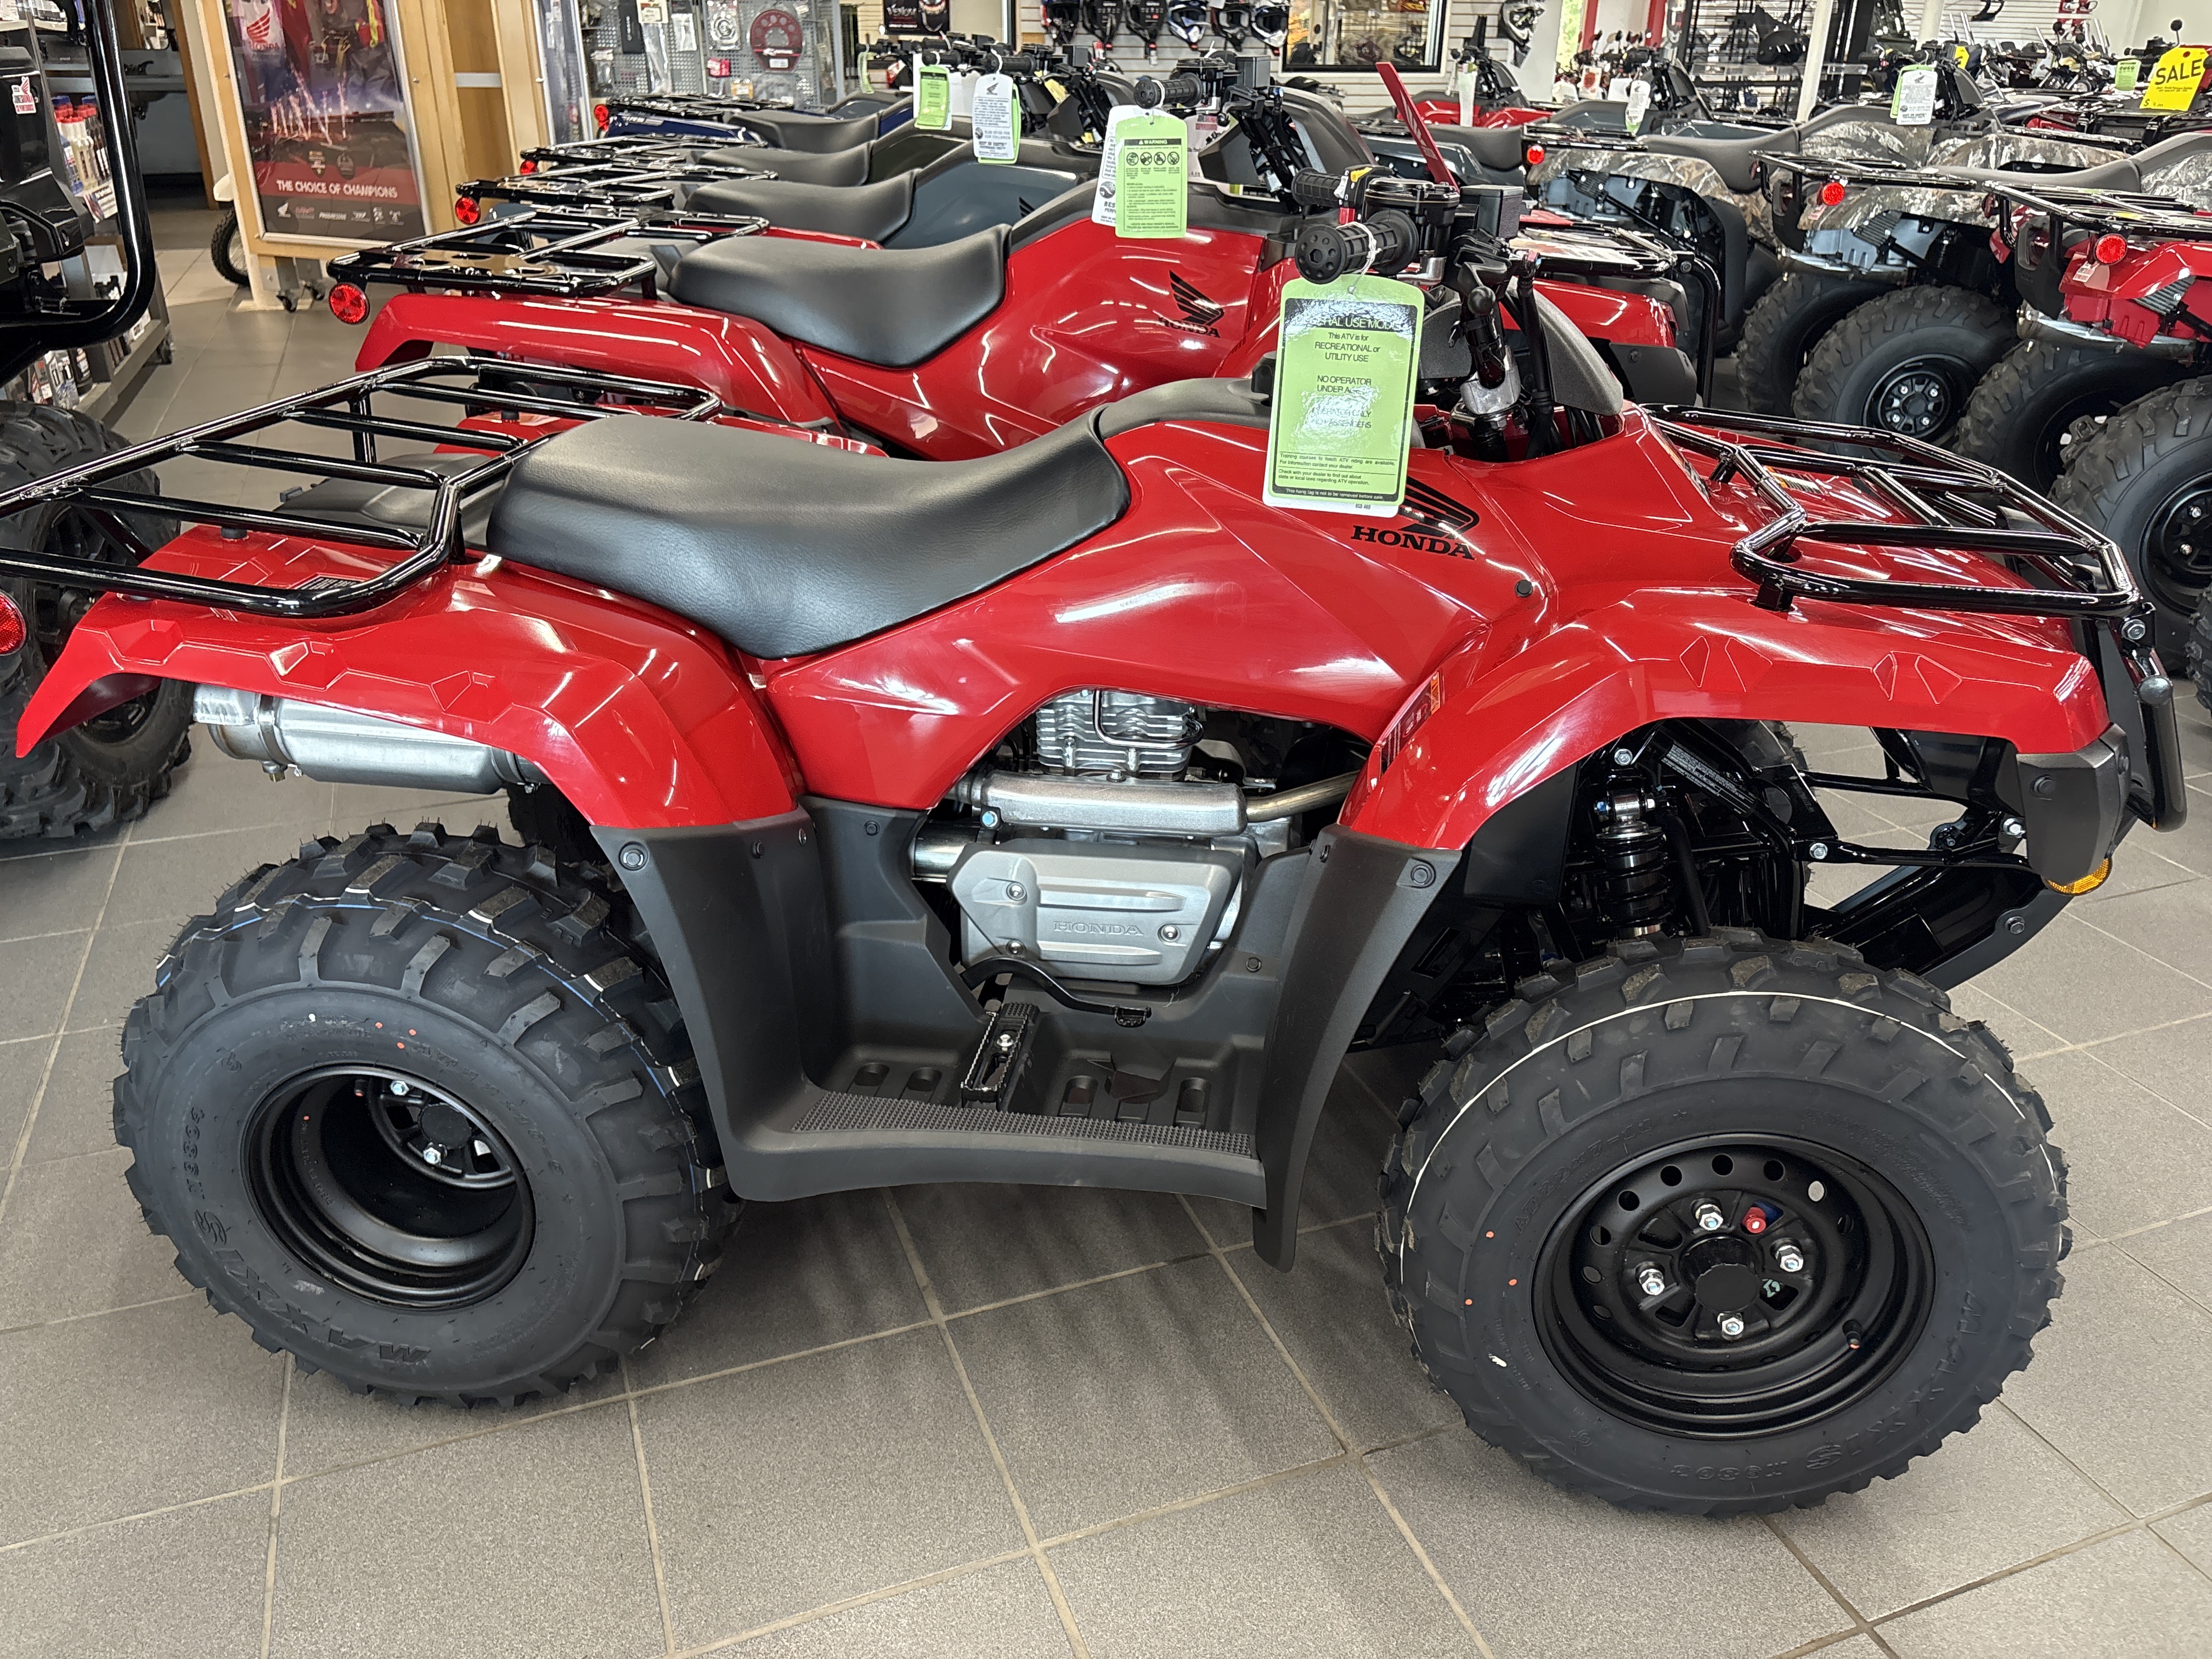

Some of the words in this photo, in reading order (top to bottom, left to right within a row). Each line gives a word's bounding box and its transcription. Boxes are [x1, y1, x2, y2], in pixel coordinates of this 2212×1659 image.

[2154, 59, 2203, 85] SALE
[276, 179, 294, 192] THE
[295, 180, 327, 194] CHOICE
[329, 182, 341, 195] OF
[343, 184, 398, 199] CHAMPIONS
[1345, 318, 1367, 328] USE
[1315, 341, 1372, 352] RECREATIONAL
[1325, 352, 1352, 361] UTILITY
[1330, 376, 1372, 385] OPERATOR
[1351, 526, 1476, 560] HONDA
[1053, 921, 1144, 936] HONDA
